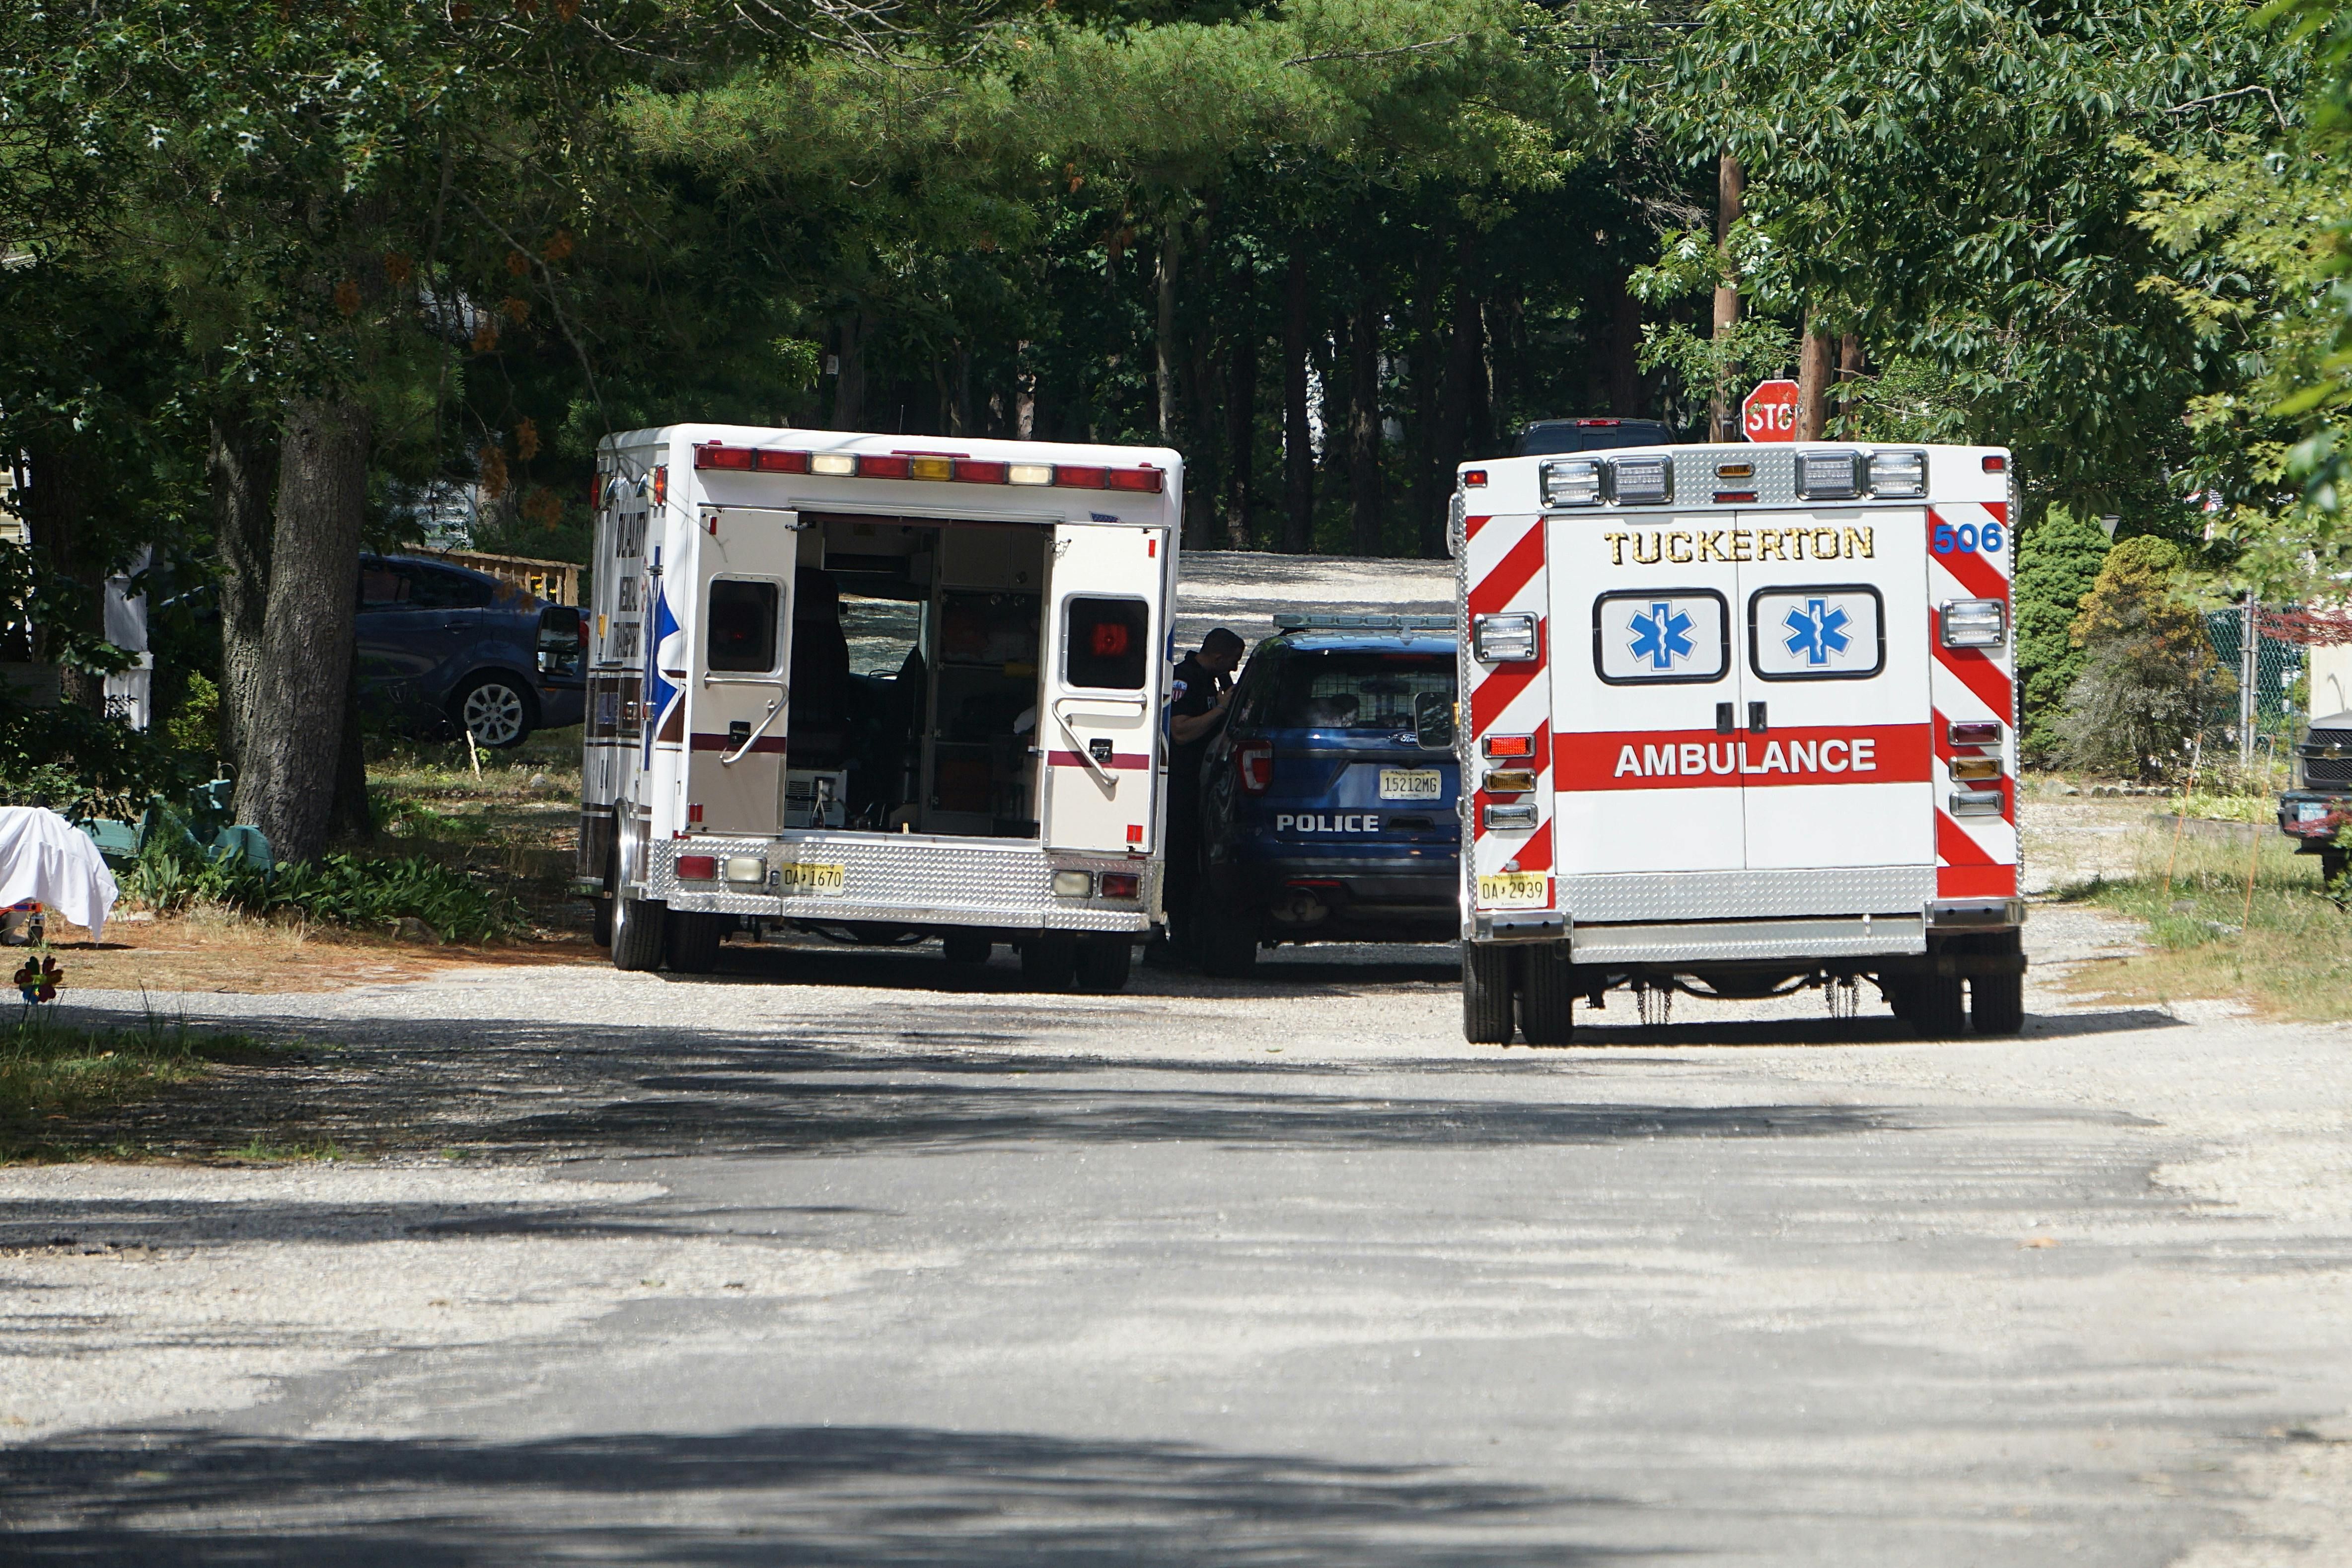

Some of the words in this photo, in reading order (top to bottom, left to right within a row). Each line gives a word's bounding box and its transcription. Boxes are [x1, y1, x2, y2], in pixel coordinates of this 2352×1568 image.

[1747, 403, 1798, 431] STO
[1604, 525, 1875, 565] TUCKERTON
[1933, 523, 2003, 554] 506
[1614, 739, 1876, 777] AMBULANCE
[1384, 777, 1437, 793] 15212MG
[1277, 815, 1379, 832] POLICE
